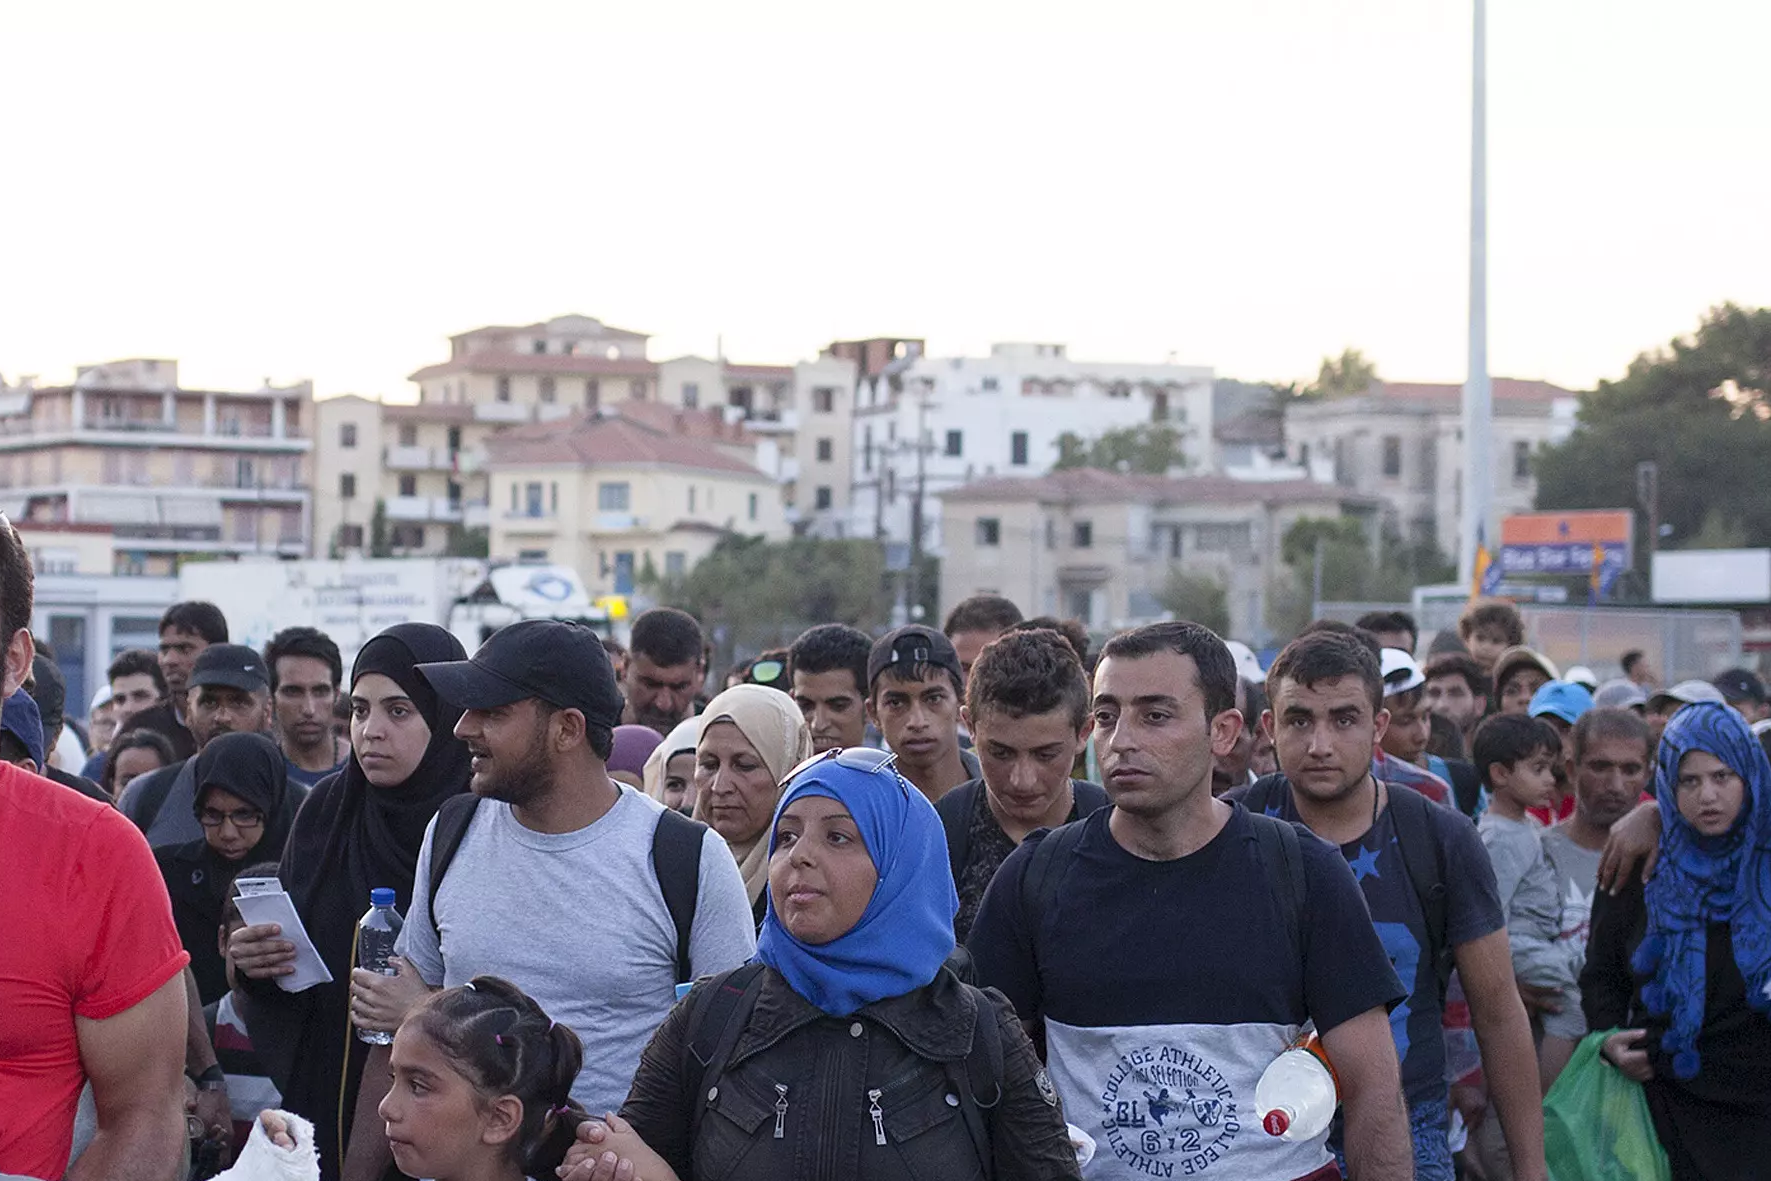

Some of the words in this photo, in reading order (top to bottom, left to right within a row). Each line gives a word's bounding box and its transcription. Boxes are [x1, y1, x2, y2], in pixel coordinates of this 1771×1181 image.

[1159, 1046, 1233, 1101] ATHLETIC
[1116, 1100, 1146, 1125] BL
[1101, 1118, 1174, 1178] ATHLETIC
